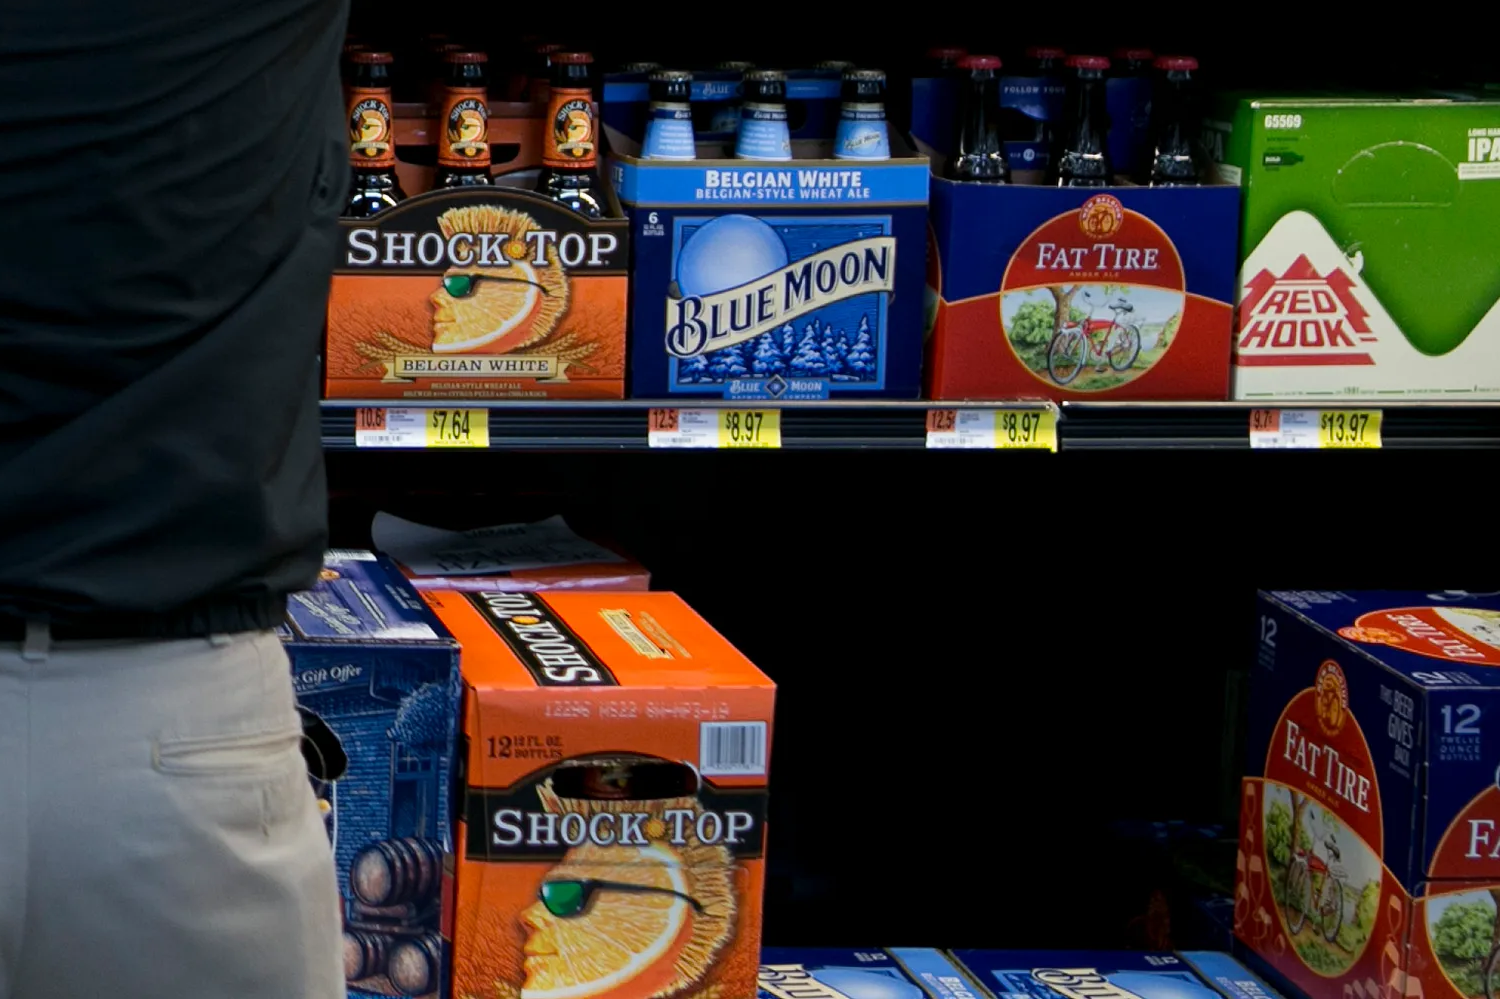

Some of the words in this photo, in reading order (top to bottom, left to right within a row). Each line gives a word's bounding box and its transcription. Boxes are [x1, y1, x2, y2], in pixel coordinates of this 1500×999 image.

[705, 170, 792, 188] BELGIAN
[798, 170, 862, 188] WHITE
[696, 188, 795, 199] BELGIAN-STYLE
[800, 188, 844, 199] WHEAT
[848, 188, 870, 199] ALE
[648, 212, 659, 224] 6
[347, 229, 510, 266] SHOCK
[524, 232, 615, 266] TOP
[1035, 242, 1092, 270] FAT
[1093, 244, 1159, 270] TIRE
[665, 281, 775, 358] BLUE
[783, 246, 889, 312] MOON
[1258, 290, 1337, 314] RED
[1239, 319, 1356, 348] HOOK
[404, 360, 482, 372] BELGIAN
[489, 360, 549, 372] WHITE
[729, 379, 760, 394] BLUE
[791, 381, 823, 393] MOON
[433, 410, 470, 440] $7.64
[726, 413, 763, 442] $8.97
[1003, 413, 1040, 442] $8.97
[1321, 414, 1369, 442] $13.97
[302, 668, 328, 687] Gift
[331, 663, 363, 682] Offer
[1440, 704, 1481, 734] 12
[1440, 745, 1481, 754] OUNCE
[1284, 719, 1321, 778] FAT
[1321, 746, 1371, 812] TIRE
[493, 809, 650, 846] SHOCK
[661, 811, 753, 845] TOP
